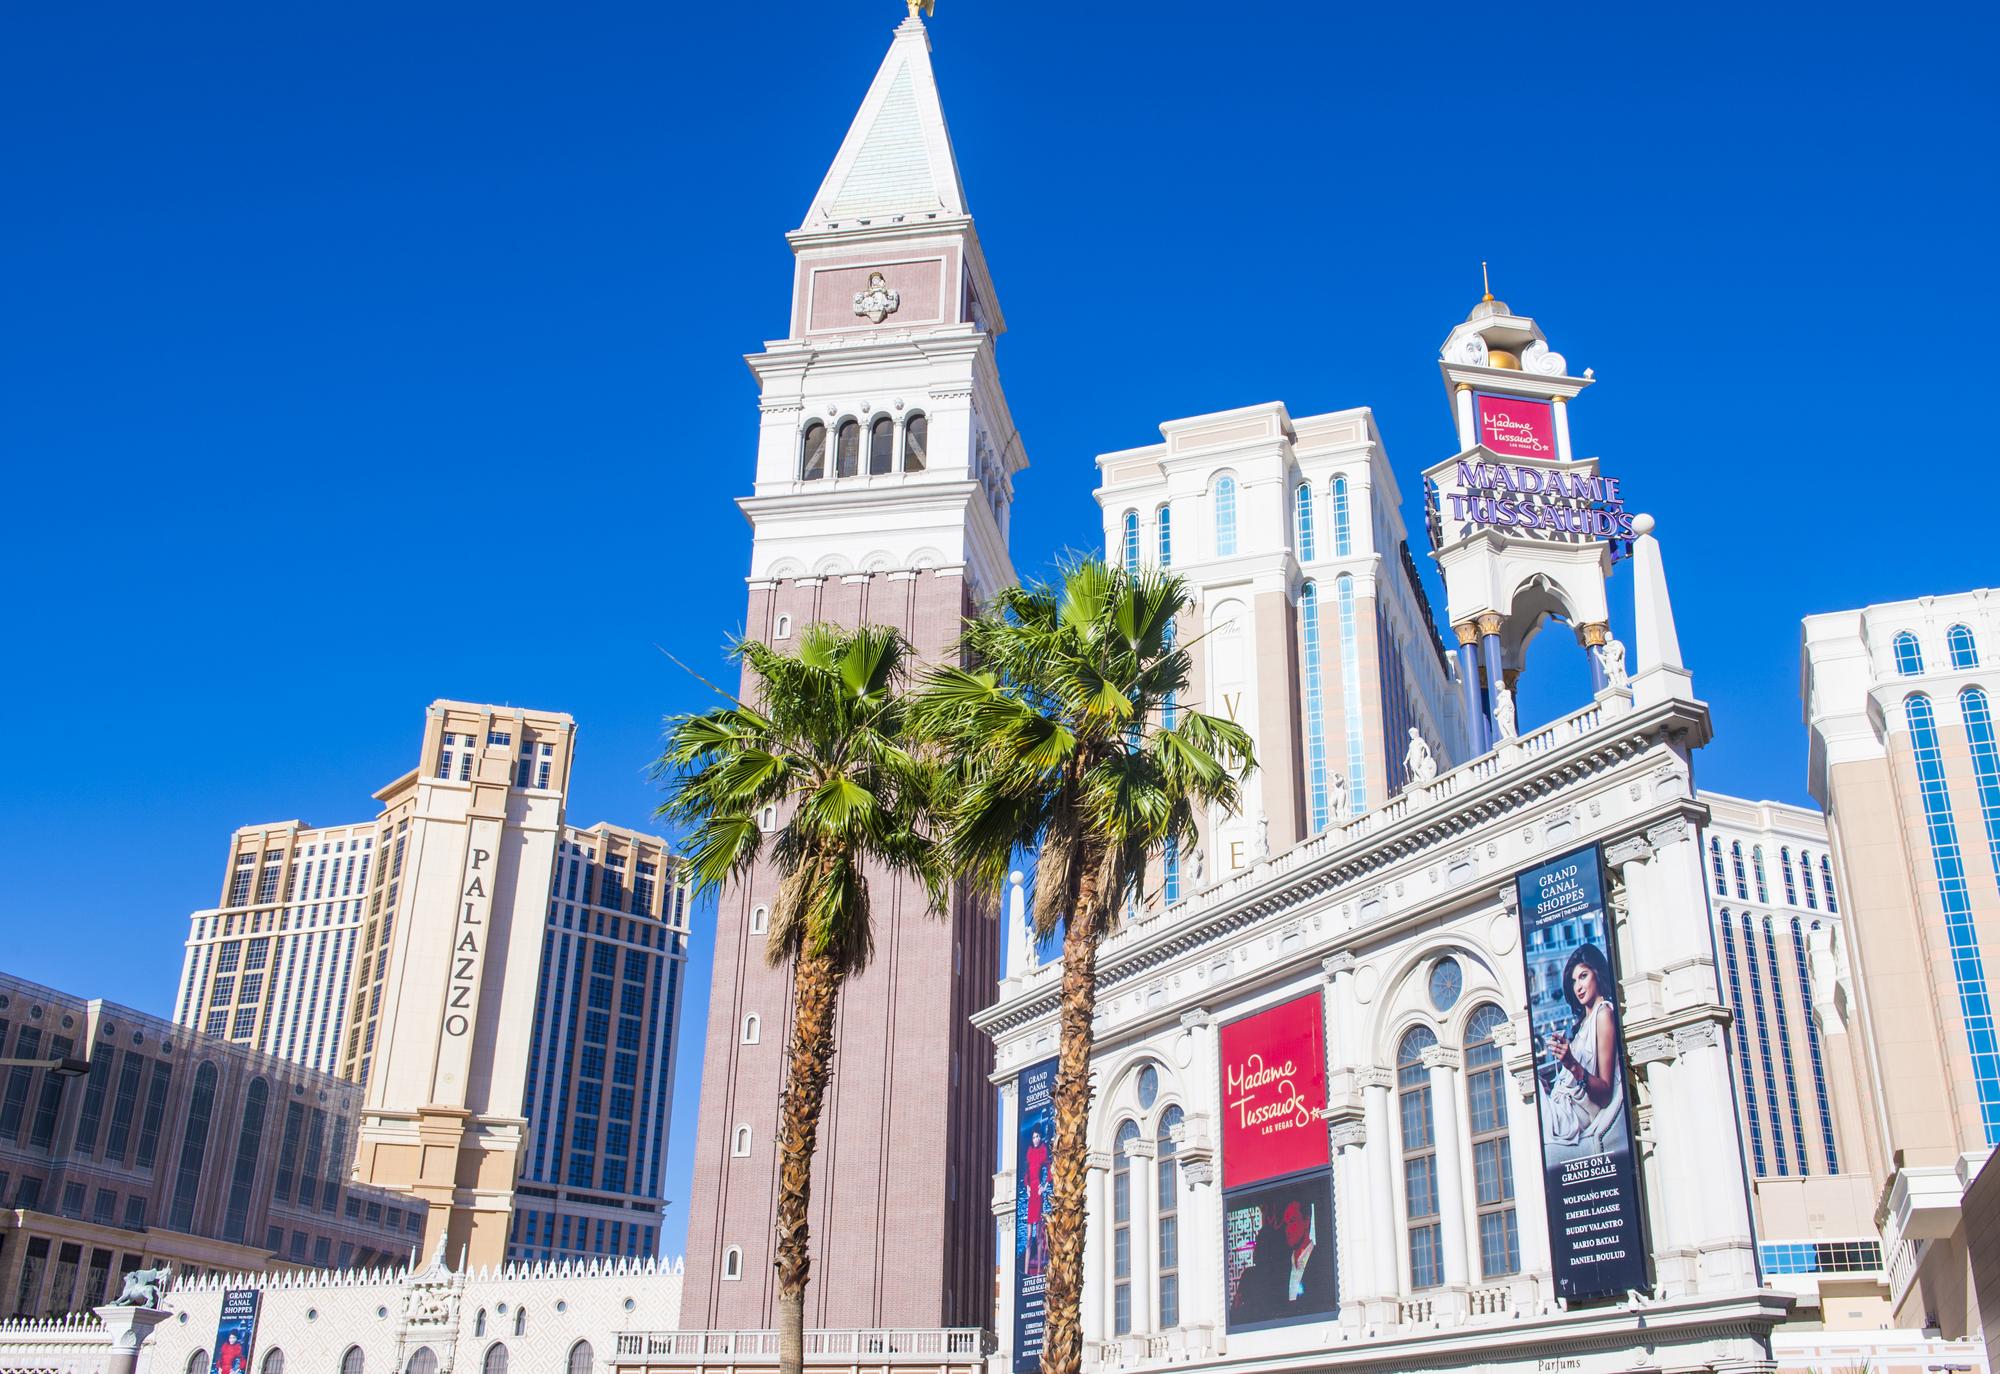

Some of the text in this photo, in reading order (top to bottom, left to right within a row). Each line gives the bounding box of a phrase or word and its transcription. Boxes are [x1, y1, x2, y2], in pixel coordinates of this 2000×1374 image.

[1483, 412, 1534, 430] Madame
[1486, 427, 1542, 451] Tussauds
[1456, 461, 1624, 504] MADAME
[1539, 865, 1577, 887] GRAND
[1541, 878, 1578, 899] CANAL
[1537, 888, 1585, 914] SHOPPES
[445, 848, 490, 1037] PALAZZO
[1029, 1072, 1047, 1085] GRAND
[1227, 1053, 1297, 1096] Madame
[1029, 1081, 1046, 1093] CANAL
[1026, 1089, 1049, 1103] SHOPPES
[1230, 1079, 1310, 1129] Tussauds
[1261, 1119, 1294, 1135] LAS VEGAS
[1565, 1156, 1611, 1172] TASTE ON A
[1561, 1164, 1617, 1182] GRAND SCALE
[1563, 1188, 1620, 1205] WOLFGANG PUCK
[1565, 1203, 1621, 1220] EMERIL LAGASSE
[1565, 1218, 1624, 1236] BUDDY VALASTRO
[1572, 1235, 1620, 1250] MARIO BATALI
[1570, 1250, 1626, 1266] DANIEL BOULUD
[225, 1306, 253, 1314] SHOPPES
[1538, 1356, 1581, 1373] Parfums
